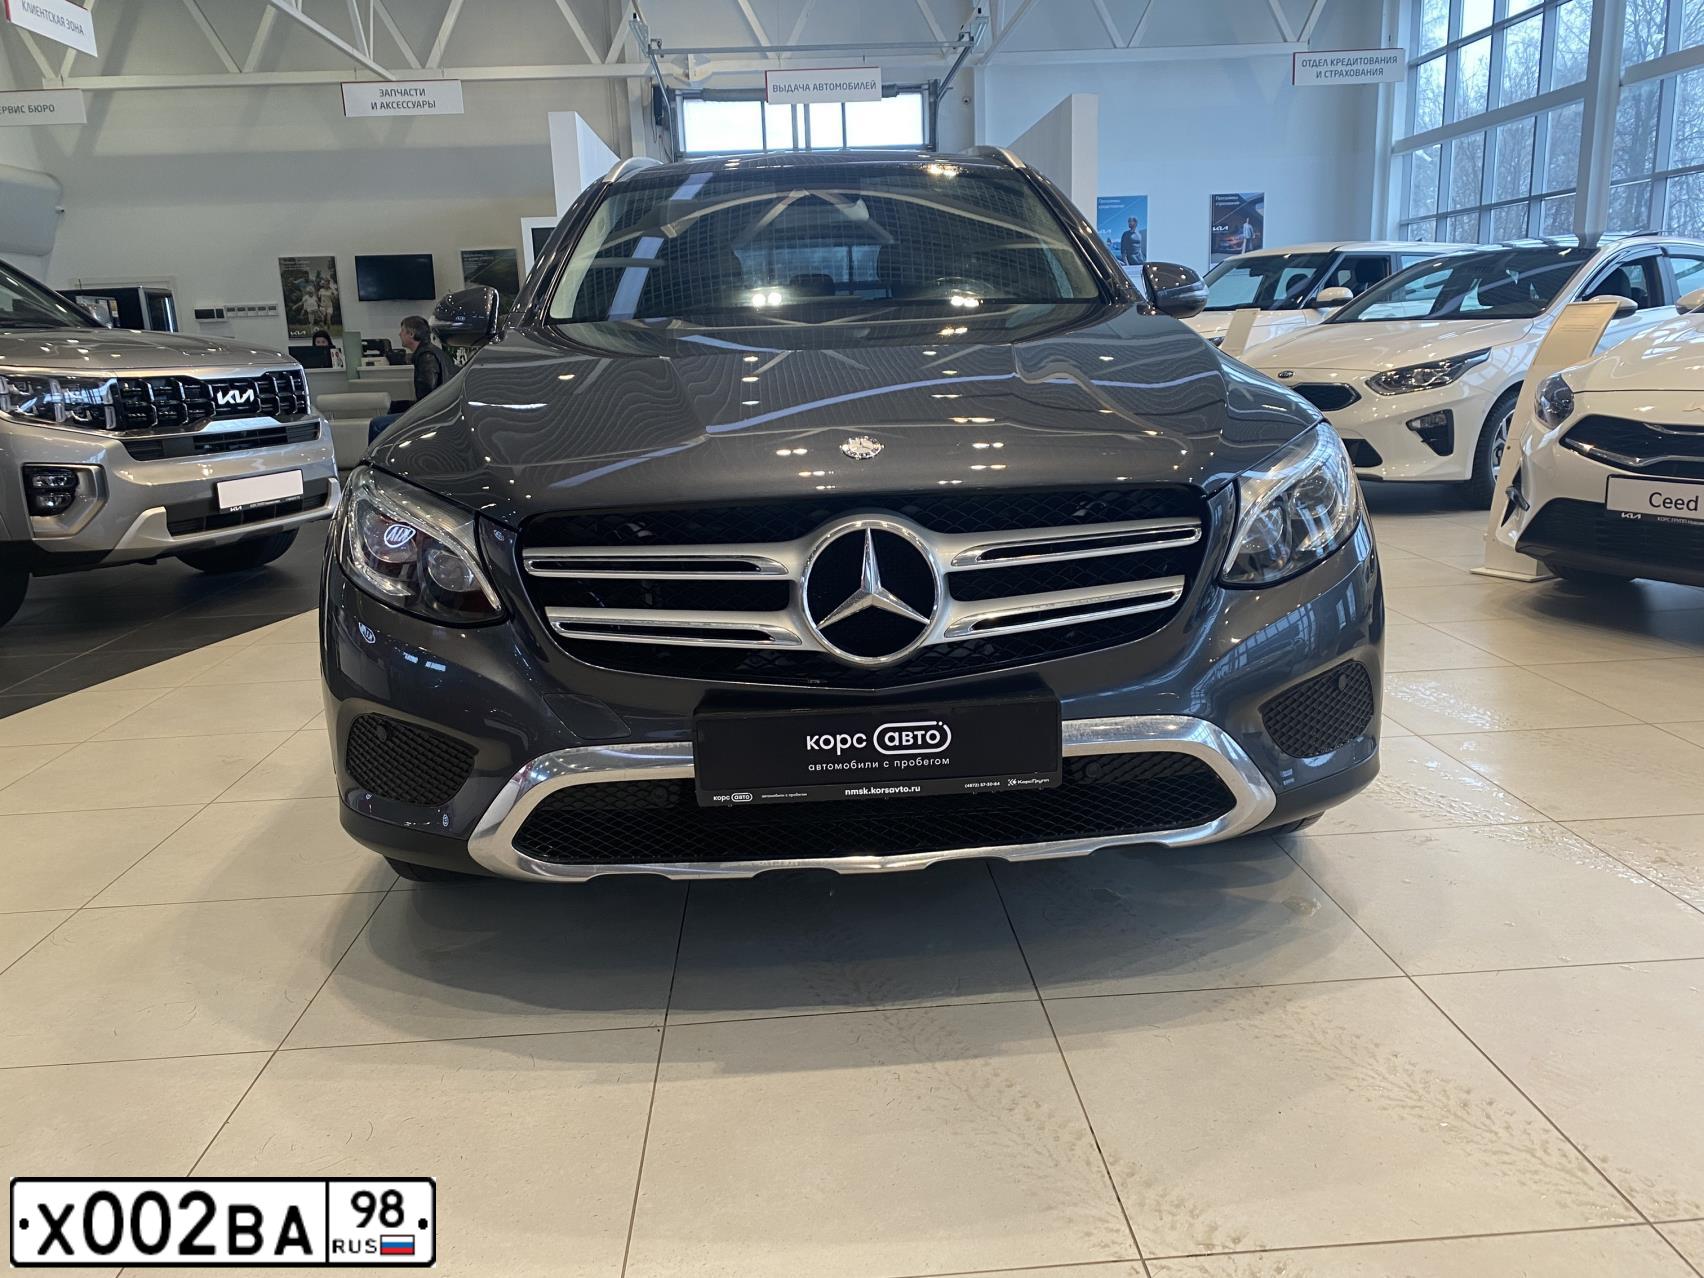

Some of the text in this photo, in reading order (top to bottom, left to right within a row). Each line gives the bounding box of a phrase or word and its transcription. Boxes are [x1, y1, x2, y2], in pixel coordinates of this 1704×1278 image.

[21, 0, 84, 35] КЛИЕНТСКАЯ ЗОНА
[1301, 56, 1398, 68] ОТДЕЛ КРЕДИТОВАНИЯ
[1316, 68, 1384, 79] И СТРАХОВАНИЯ
[379, 88, 426, 97] ЗАПЧАСТИ
[772, 80, 877, 93] ВЫДАЧА АВТОМОБИЛЕЙ
[28, 104, 55, 113] БЮРО
[371, 100, 436, 110] И АКСЕССУАРЫ
[216, 389, 254, 405] KIA
[1649, 491, 1699, 511] Ceed
[806, 730, 941, 755] корс авто
[808, 760, 879, 771] автомобили
[894, 757, 950, 769] пробегом
[845, 785, 921, 796] nmsk.korsavto.ru
